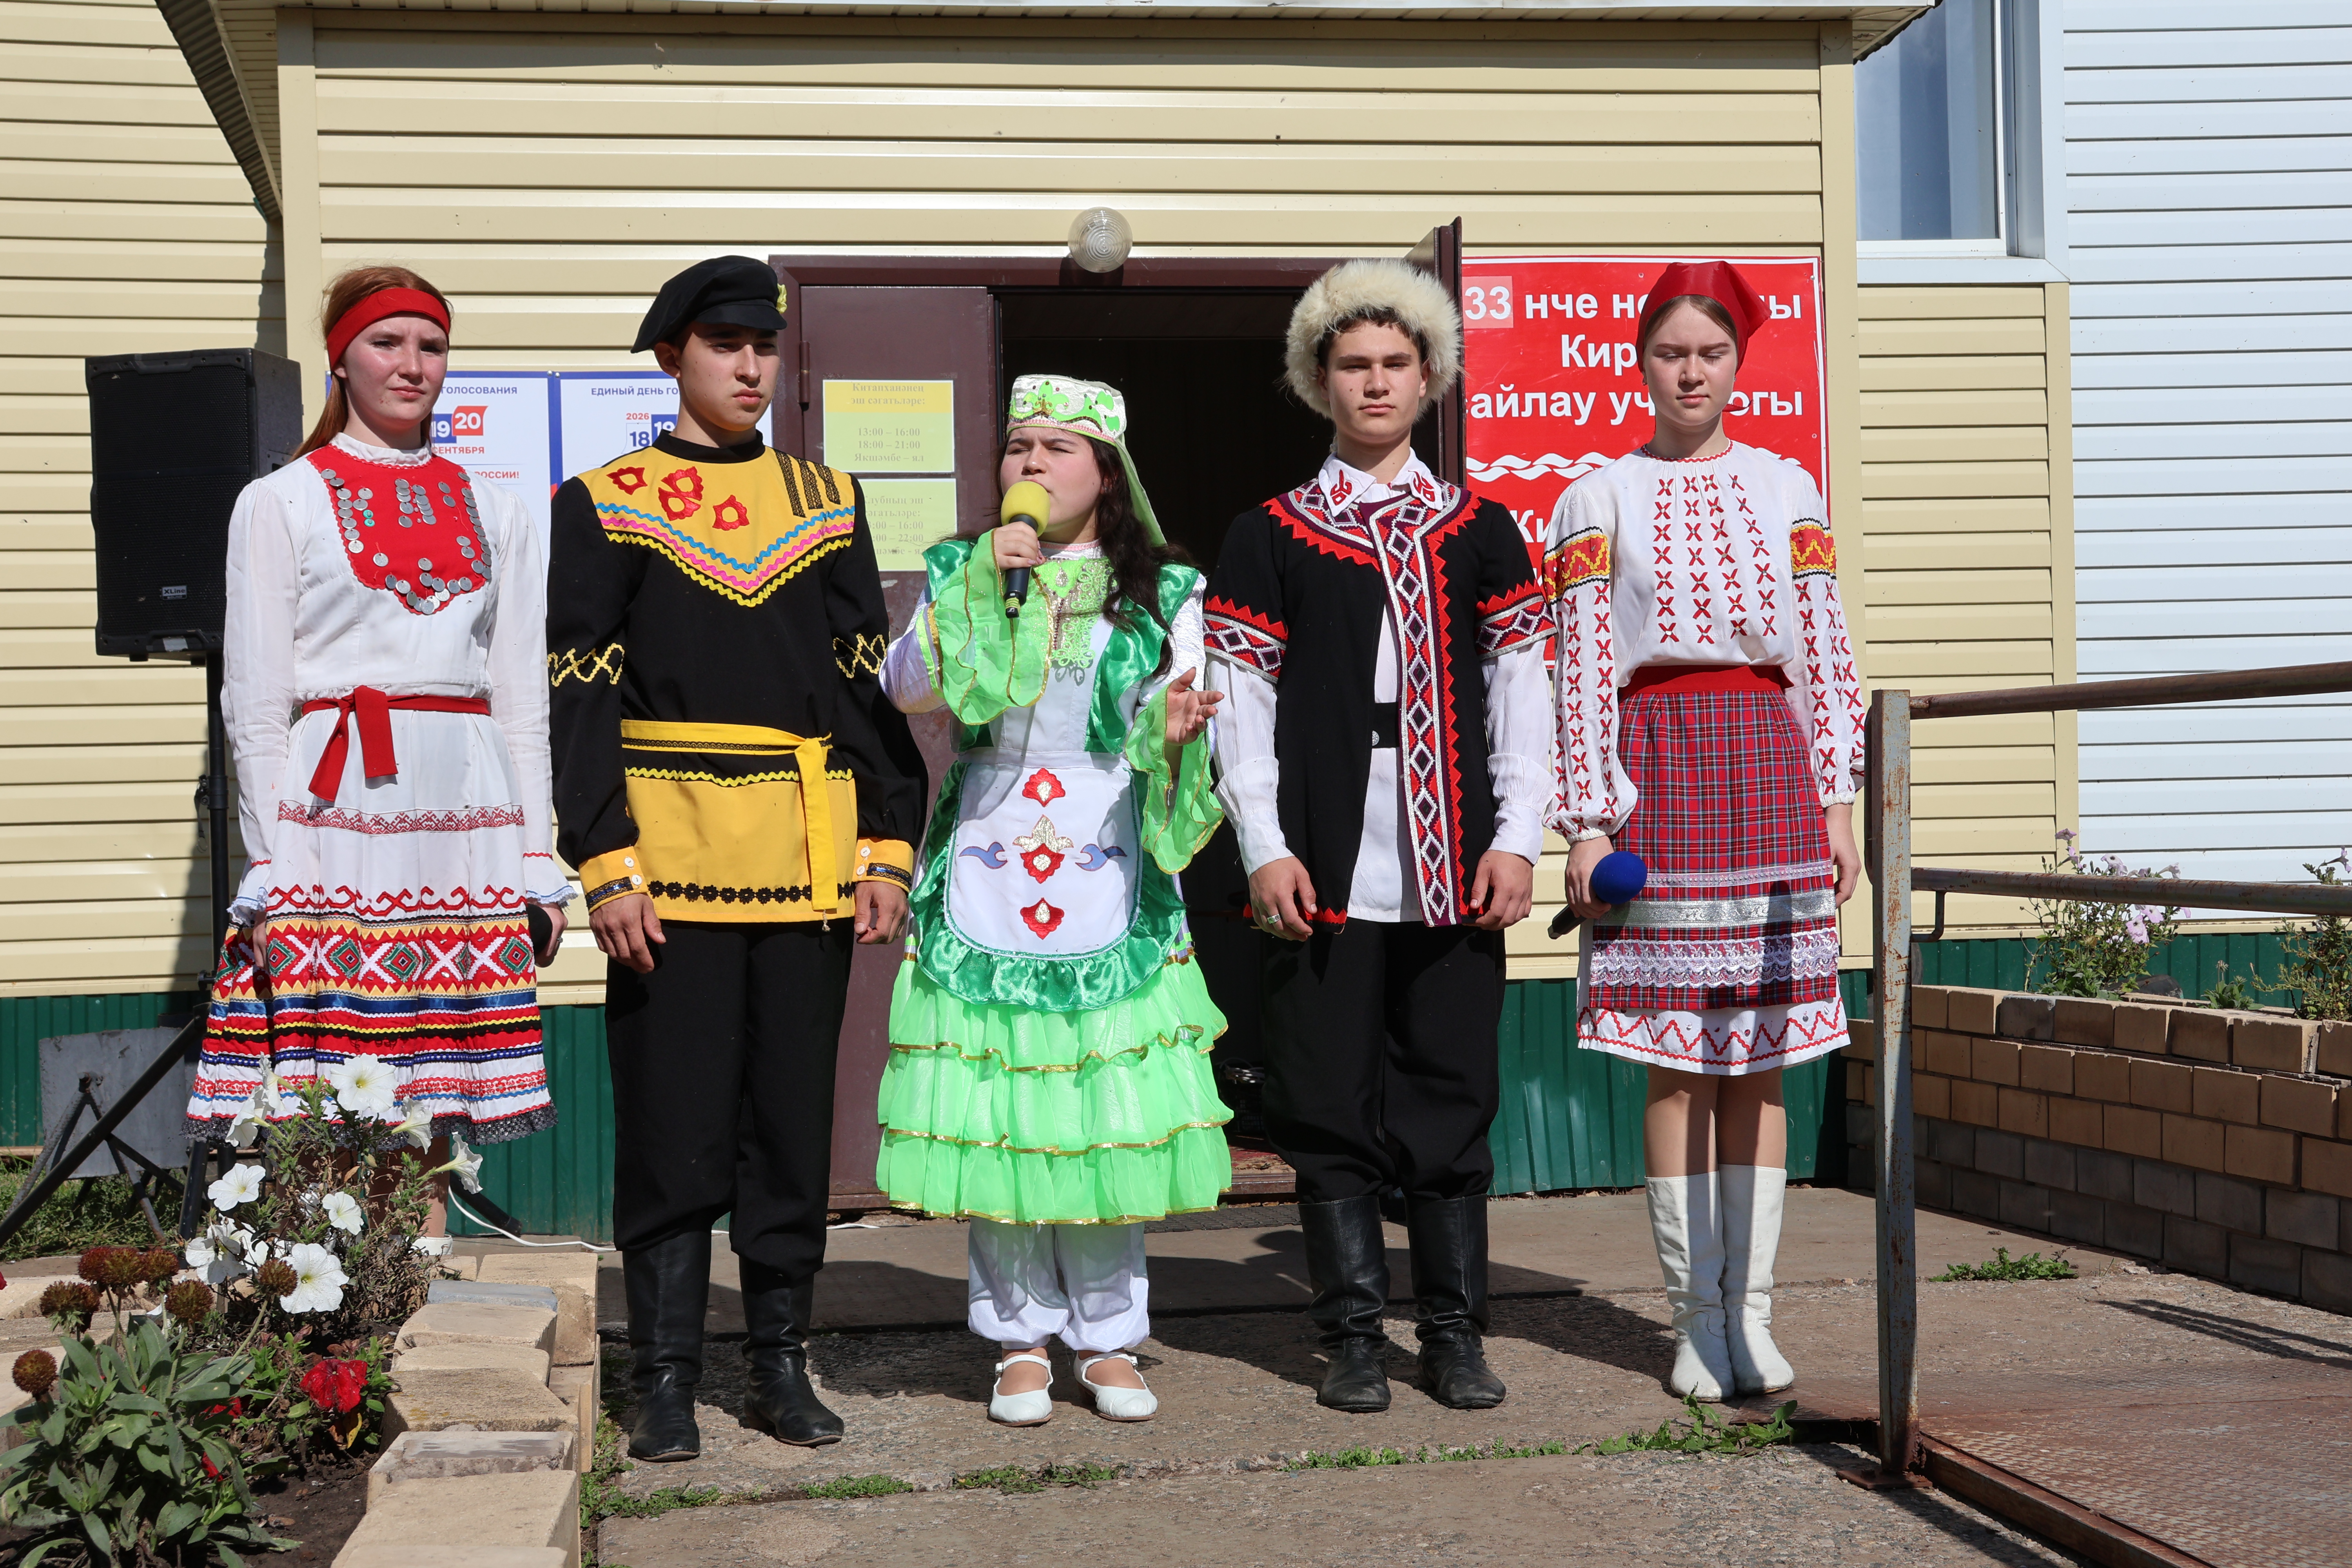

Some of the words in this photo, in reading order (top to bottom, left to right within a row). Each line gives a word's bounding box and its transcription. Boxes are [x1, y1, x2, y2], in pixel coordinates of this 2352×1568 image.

[1465, 286, 1511, 320] 33
[1526, 294, 1598, 319] нче
[591, 386, 634, 396] ЕДИНЫЙ
[637, 387, 664, 396] ДЕНЬ
[455, 412, 481, 430] 20
[432, 421, 450, 438] 19
[858, 428, 883, 436] 13:00
[895, 428, 920, 436] 16:00
[630, 431, 650, 447] 18
[858, 441, 883, 449] 18:00
[895, 441, 920, 449] 21:00
[898, 521, 923, 529] 16:00
